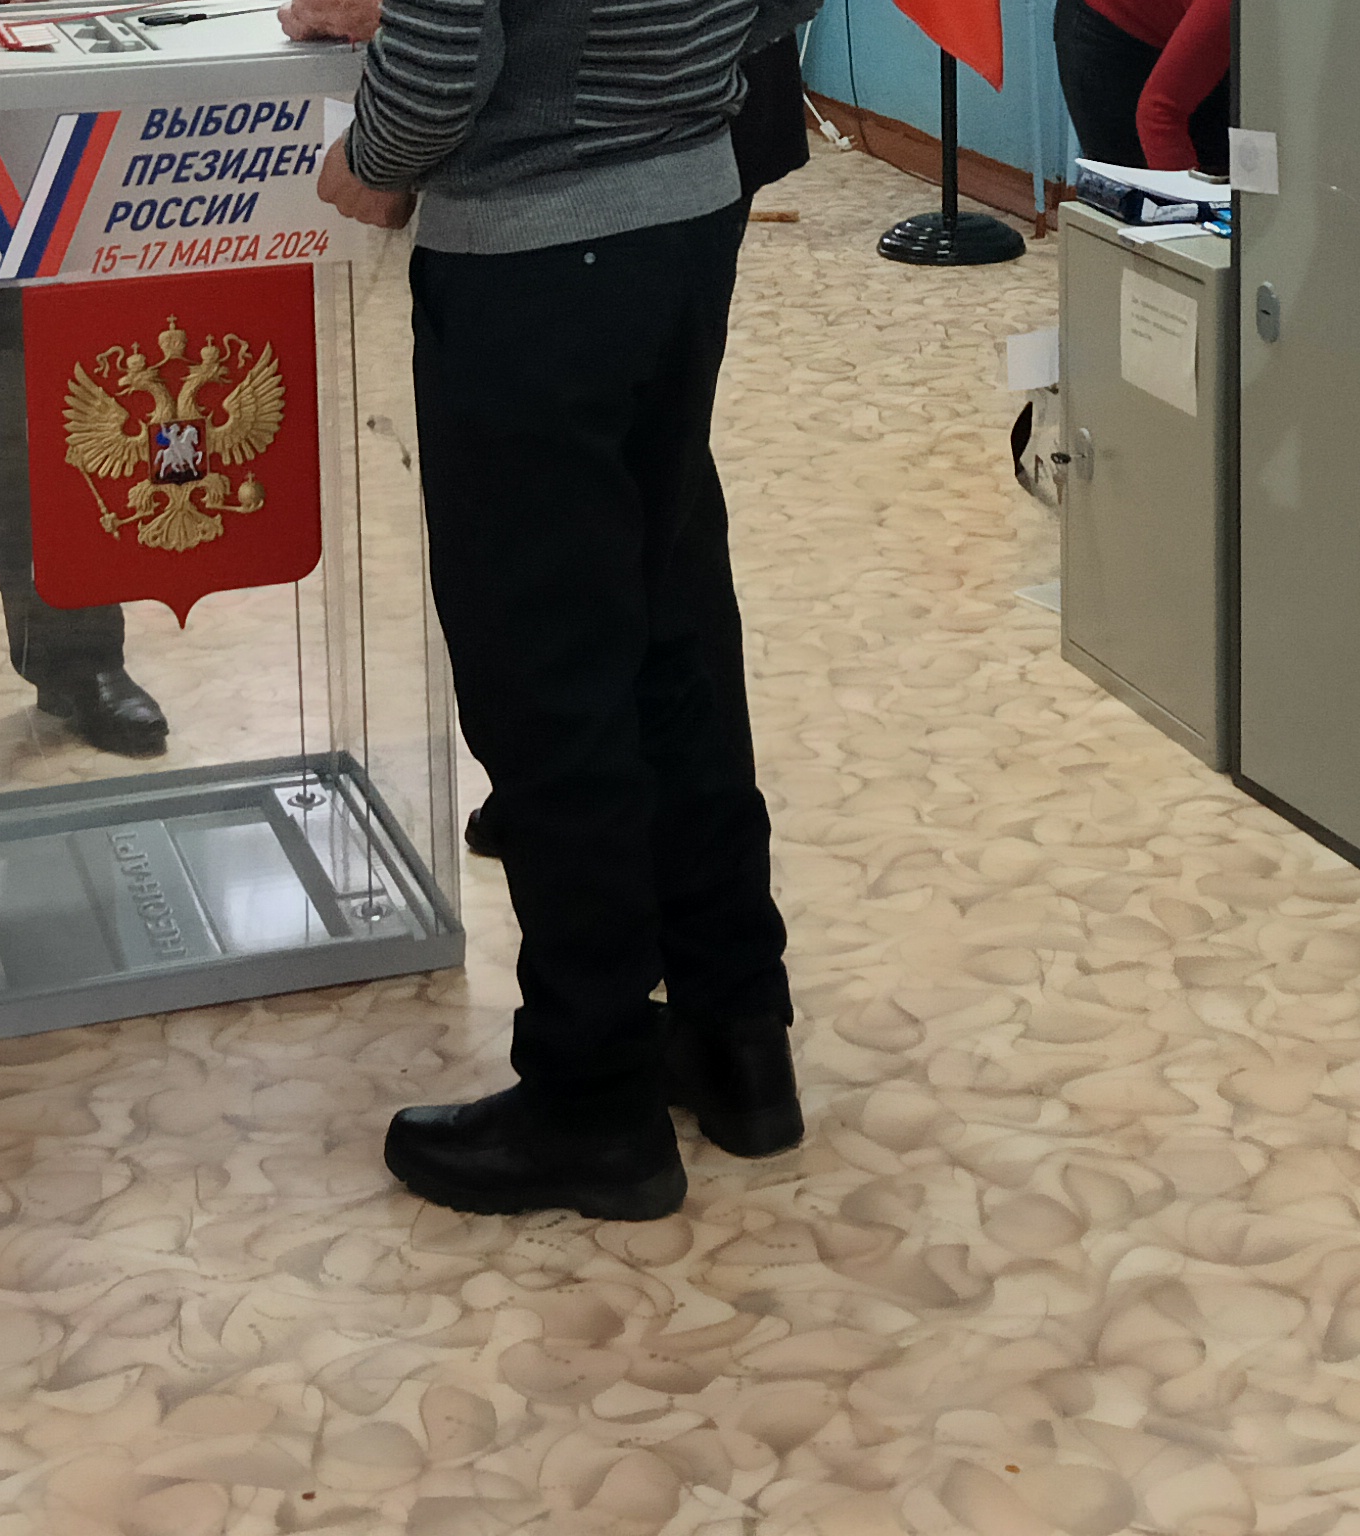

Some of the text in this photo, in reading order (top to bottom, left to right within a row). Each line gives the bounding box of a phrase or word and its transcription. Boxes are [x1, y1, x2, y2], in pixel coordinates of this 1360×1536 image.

[140, 99, 311, 141] ВЫБОРЫ
[121, 142, 323, 187] ПРЕЗИДЕН
[104, 192, 260, 233] РОССИИ
[170, 233, 260, 268] МАРТА
[264, 229, 330, 260] 2024
